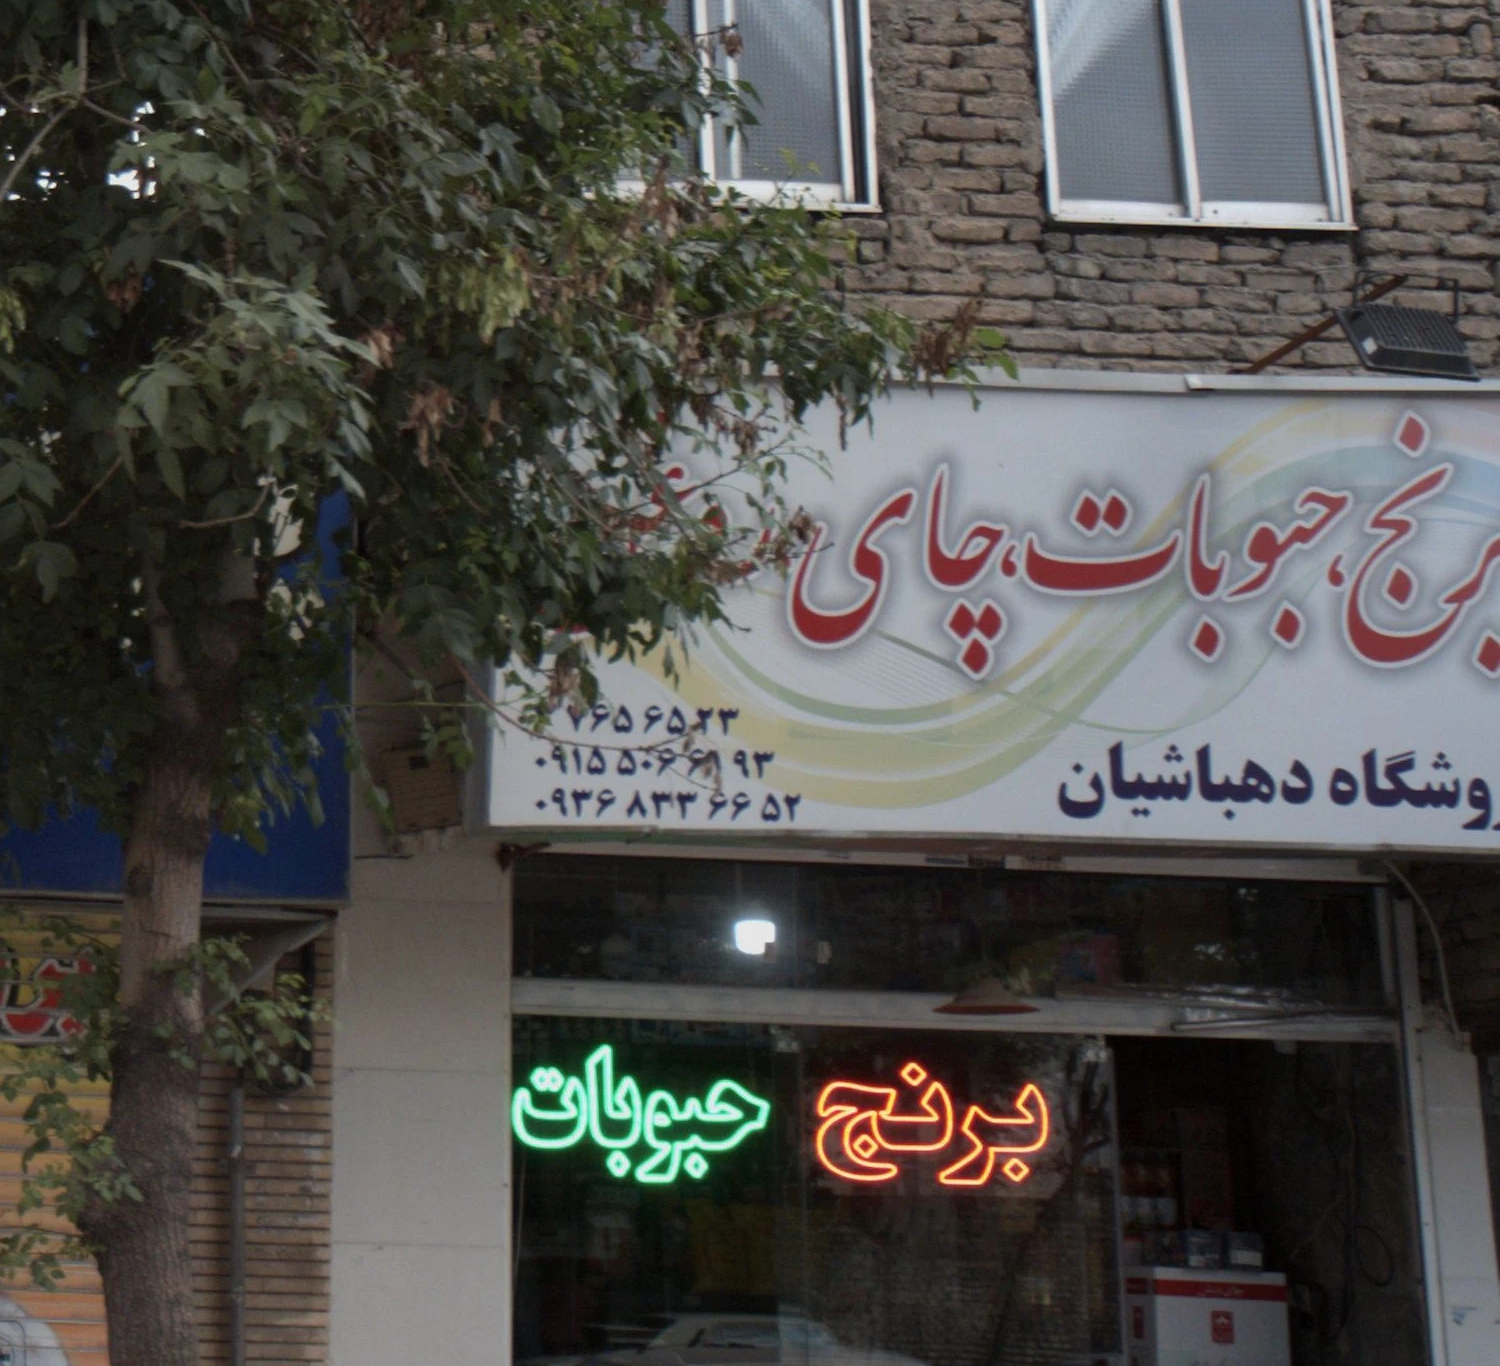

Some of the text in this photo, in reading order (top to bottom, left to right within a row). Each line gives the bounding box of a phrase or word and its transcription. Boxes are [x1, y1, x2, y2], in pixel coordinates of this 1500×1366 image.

[1057, 740, 1500, 831] وشگاه دهباشیان
[510, 1043, 1050, 1186] برنج حبوبات
